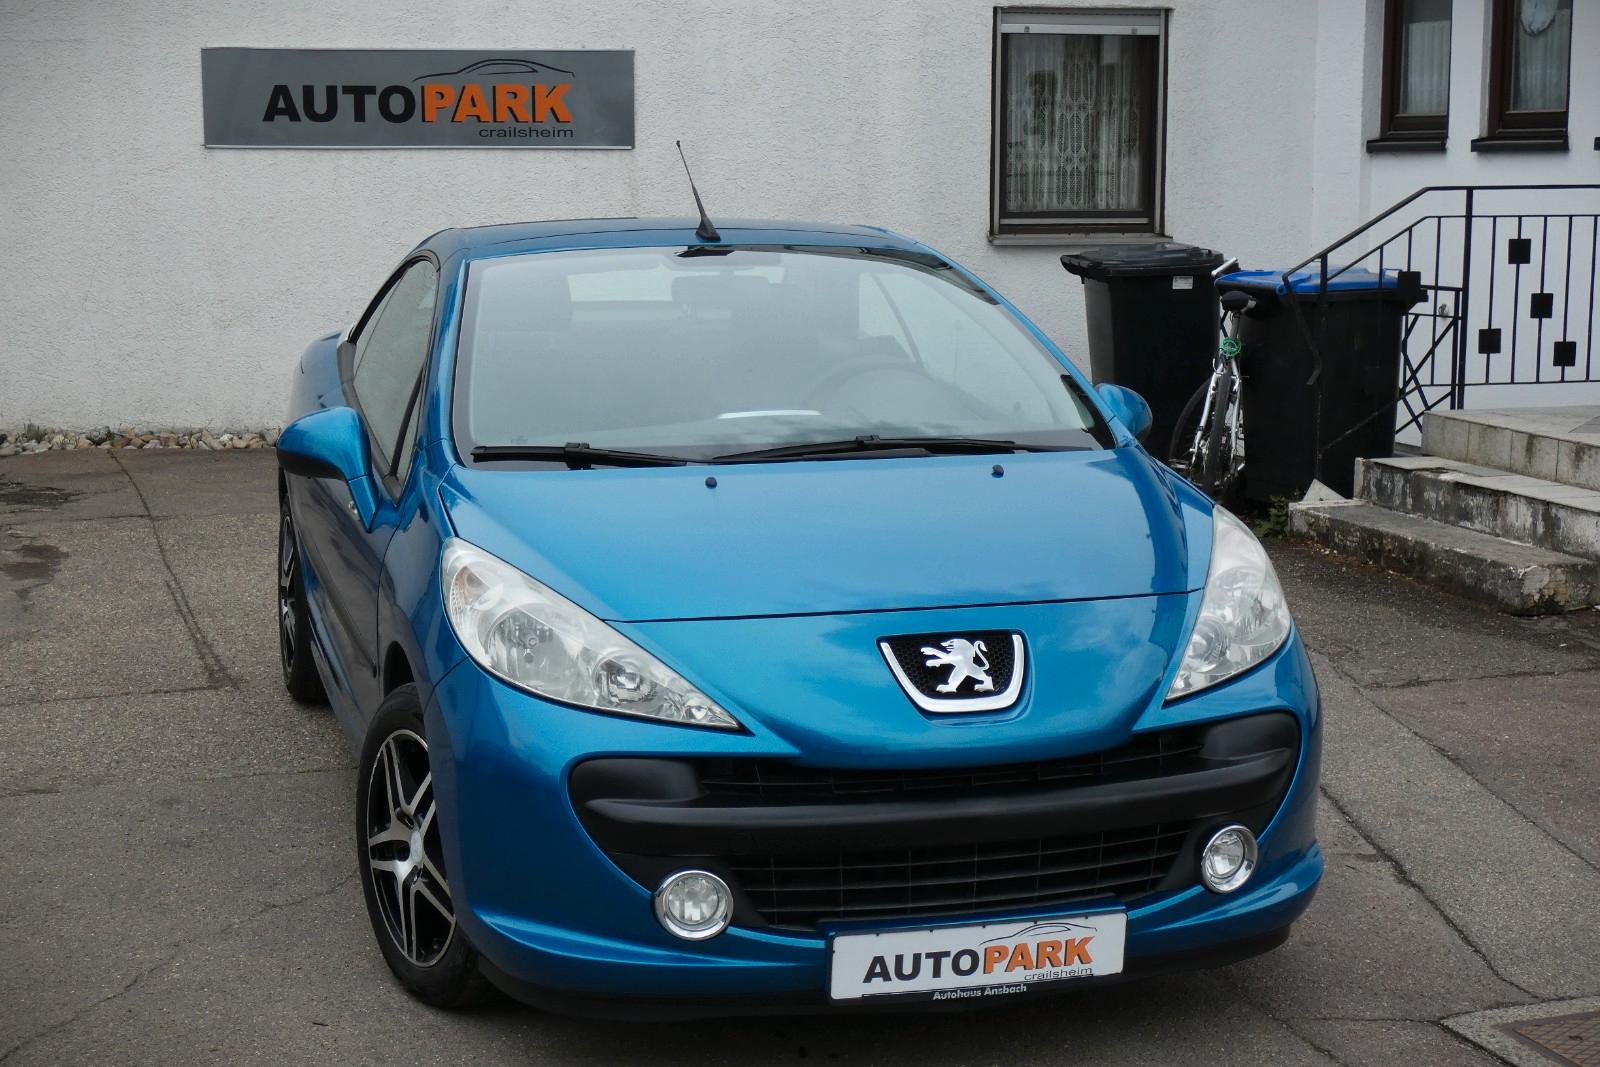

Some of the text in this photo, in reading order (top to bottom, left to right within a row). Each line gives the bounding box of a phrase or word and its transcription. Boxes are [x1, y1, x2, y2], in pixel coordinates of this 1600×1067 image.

[262, 83, 573, 123] AUTOPARK
[478, 125, 574, 138] crailsheim
[862, 936, 1095, 983] AUTOPARK
[1024, 967, 1093, 981] crailsheim
[933, 984, 1027, 1001] Autohaus Ansbach
